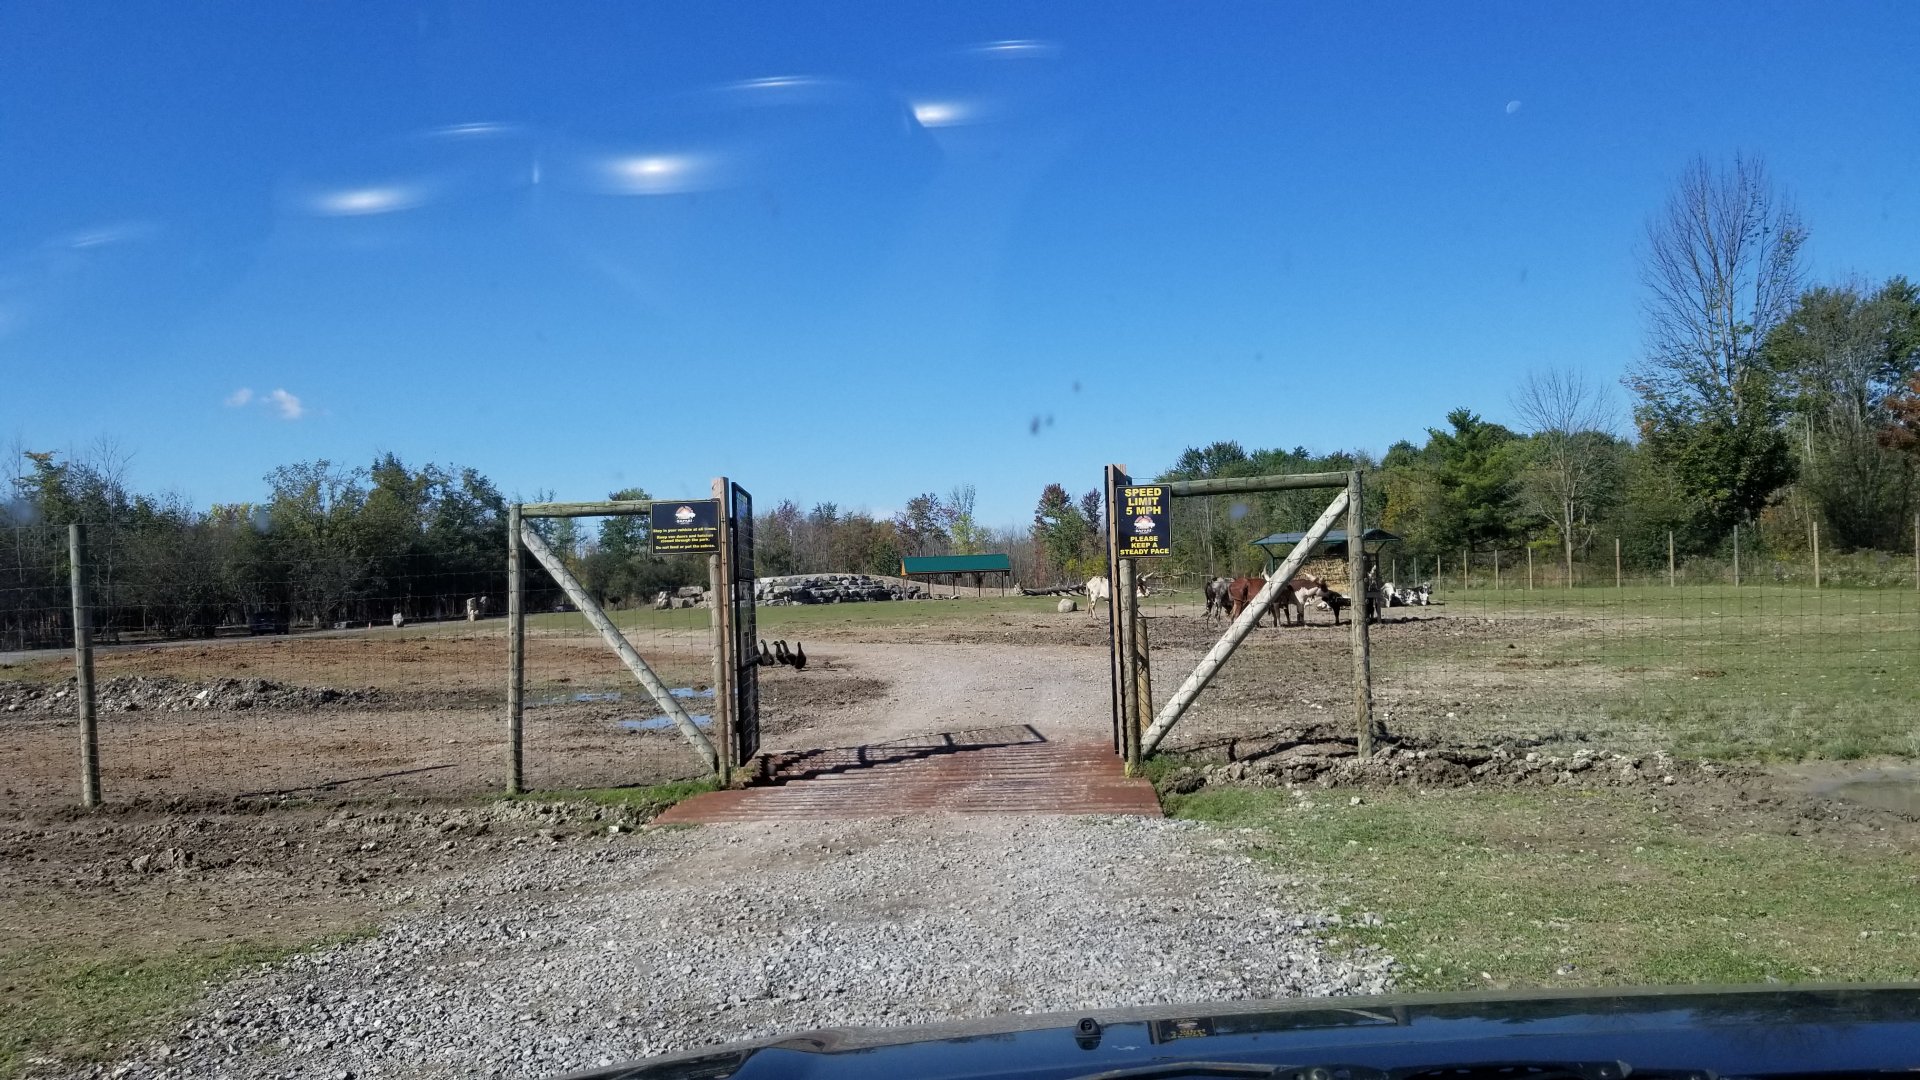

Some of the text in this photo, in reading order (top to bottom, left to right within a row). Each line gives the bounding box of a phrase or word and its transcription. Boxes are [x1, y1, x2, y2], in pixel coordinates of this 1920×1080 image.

[1125, 488, 1162, 497] SPEED
[1128, 497, 1159, 506] LIMIT
[1126, 506, 1162, 516] 5 MPH
